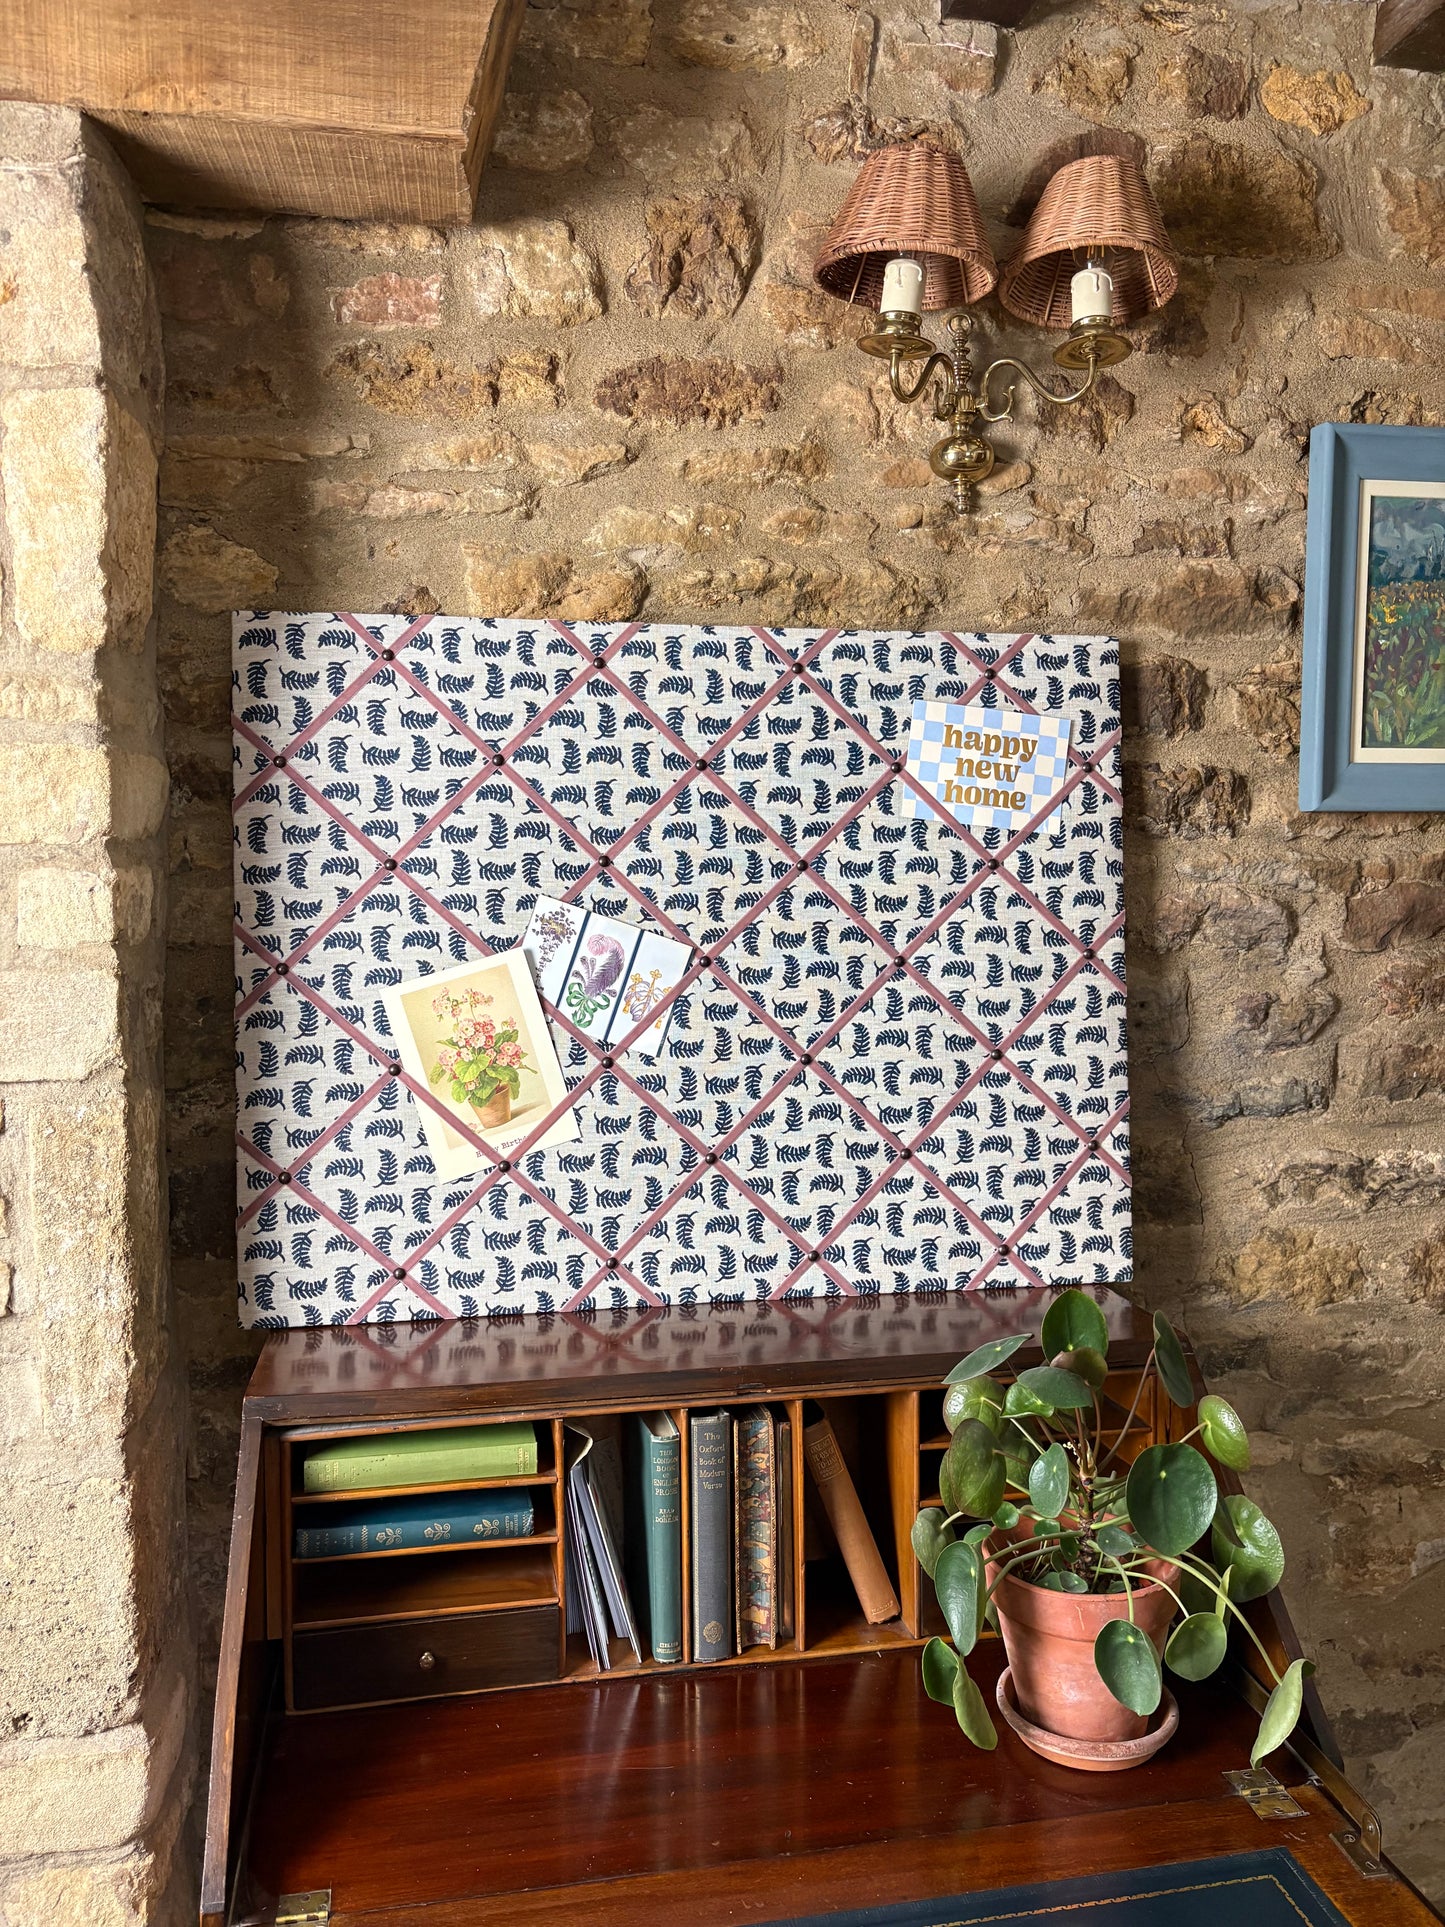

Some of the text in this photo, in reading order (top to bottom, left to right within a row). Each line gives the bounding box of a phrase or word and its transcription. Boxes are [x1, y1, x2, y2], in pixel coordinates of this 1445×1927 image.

[943, 724, 1038, 763] happy
[954, 757, 1021, 783] new
[943, 779, 1026, 811] home
[704, 1432, 720, 1440] The
[699, 1443, 725, 1453] Oxford
[653, 1455, 678, 1465] LONDON
[699, 1455, 726, 1466] Book of
[699, 1469, 726, 1478] Modern
[703, 1481, 723, 1490] Verse
